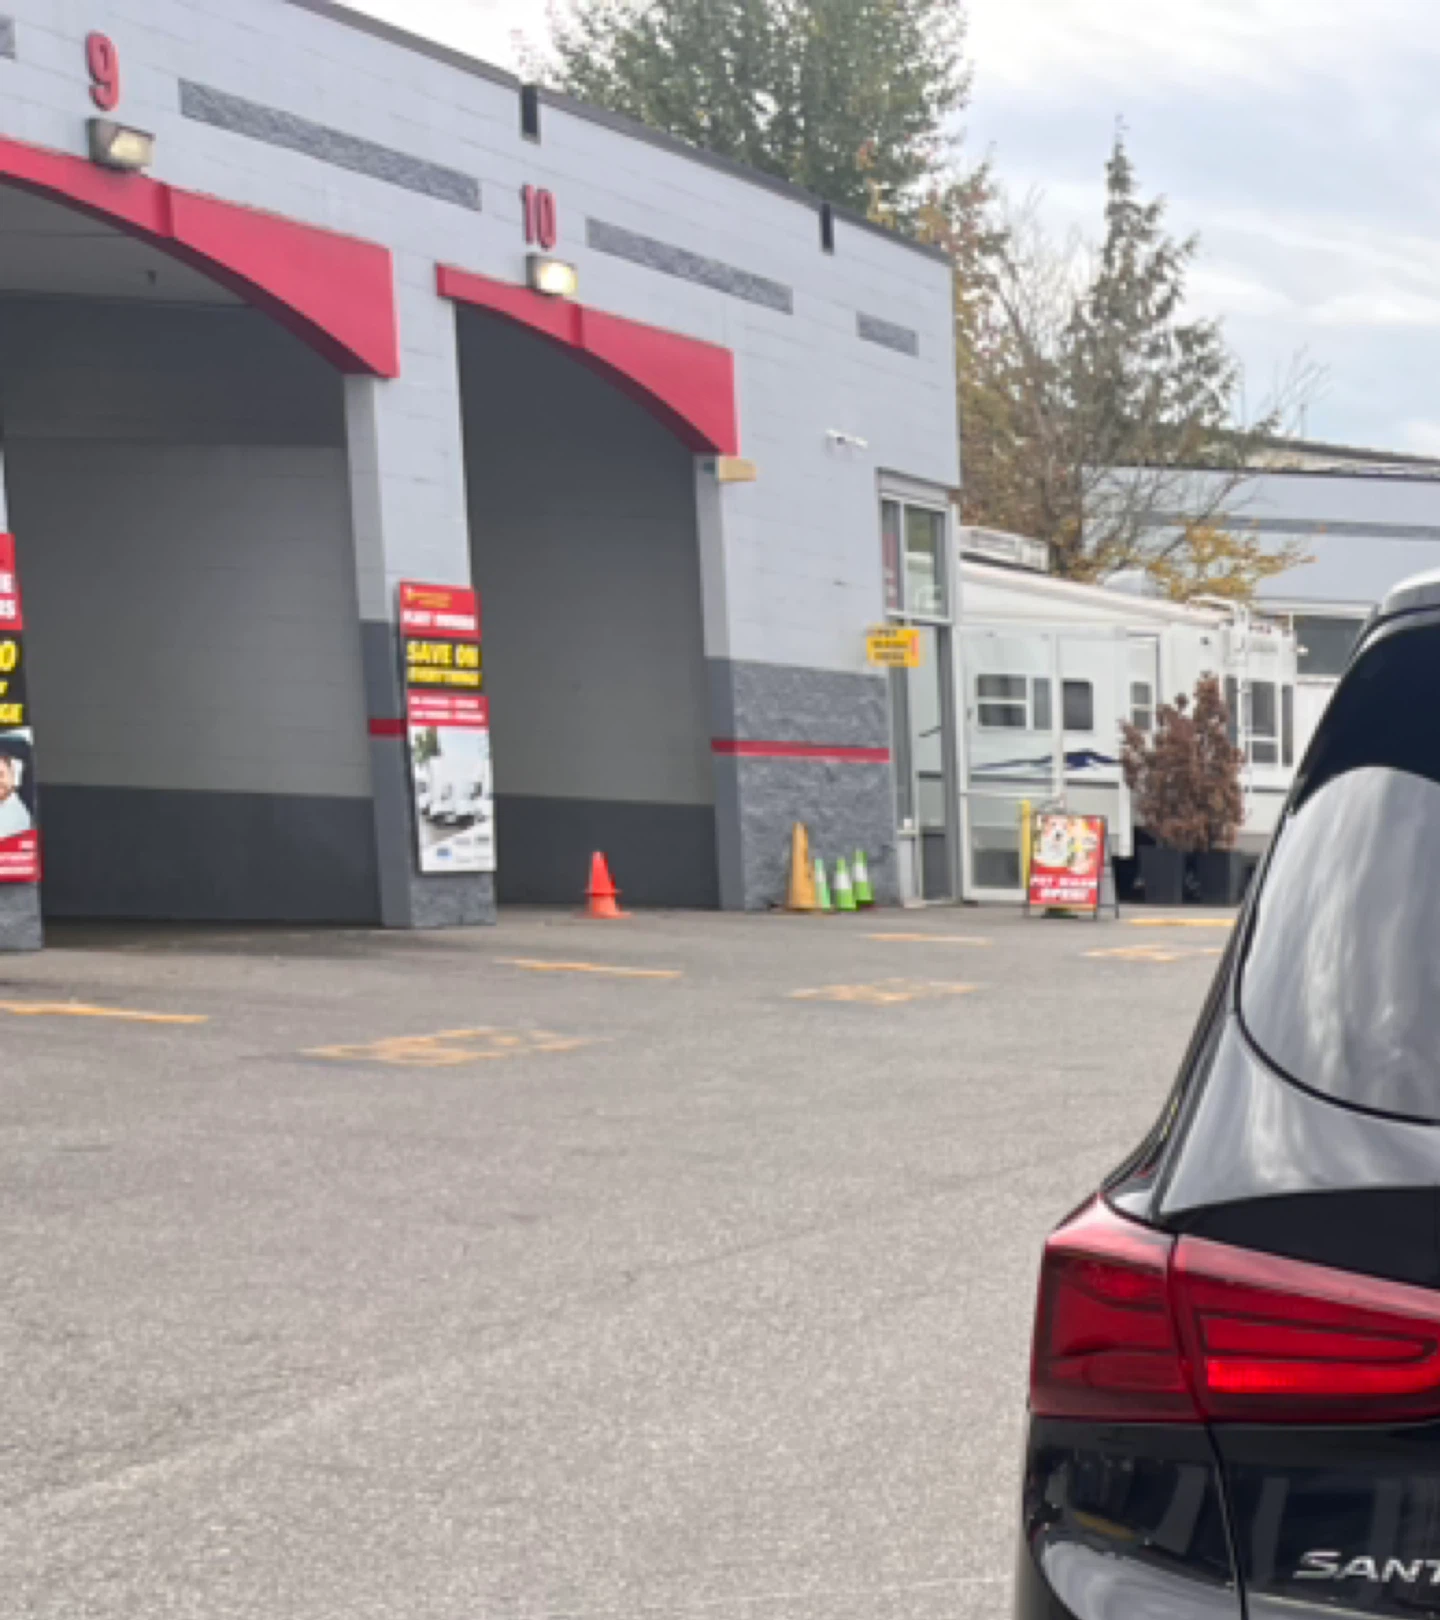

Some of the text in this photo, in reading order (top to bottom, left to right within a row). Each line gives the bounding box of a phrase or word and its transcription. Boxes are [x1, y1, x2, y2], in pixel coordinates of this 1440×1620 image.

[85, 30, 119, 111] 9
[520, 183, 557, 250] 10
[406, 641, 453, 664] SAVE
